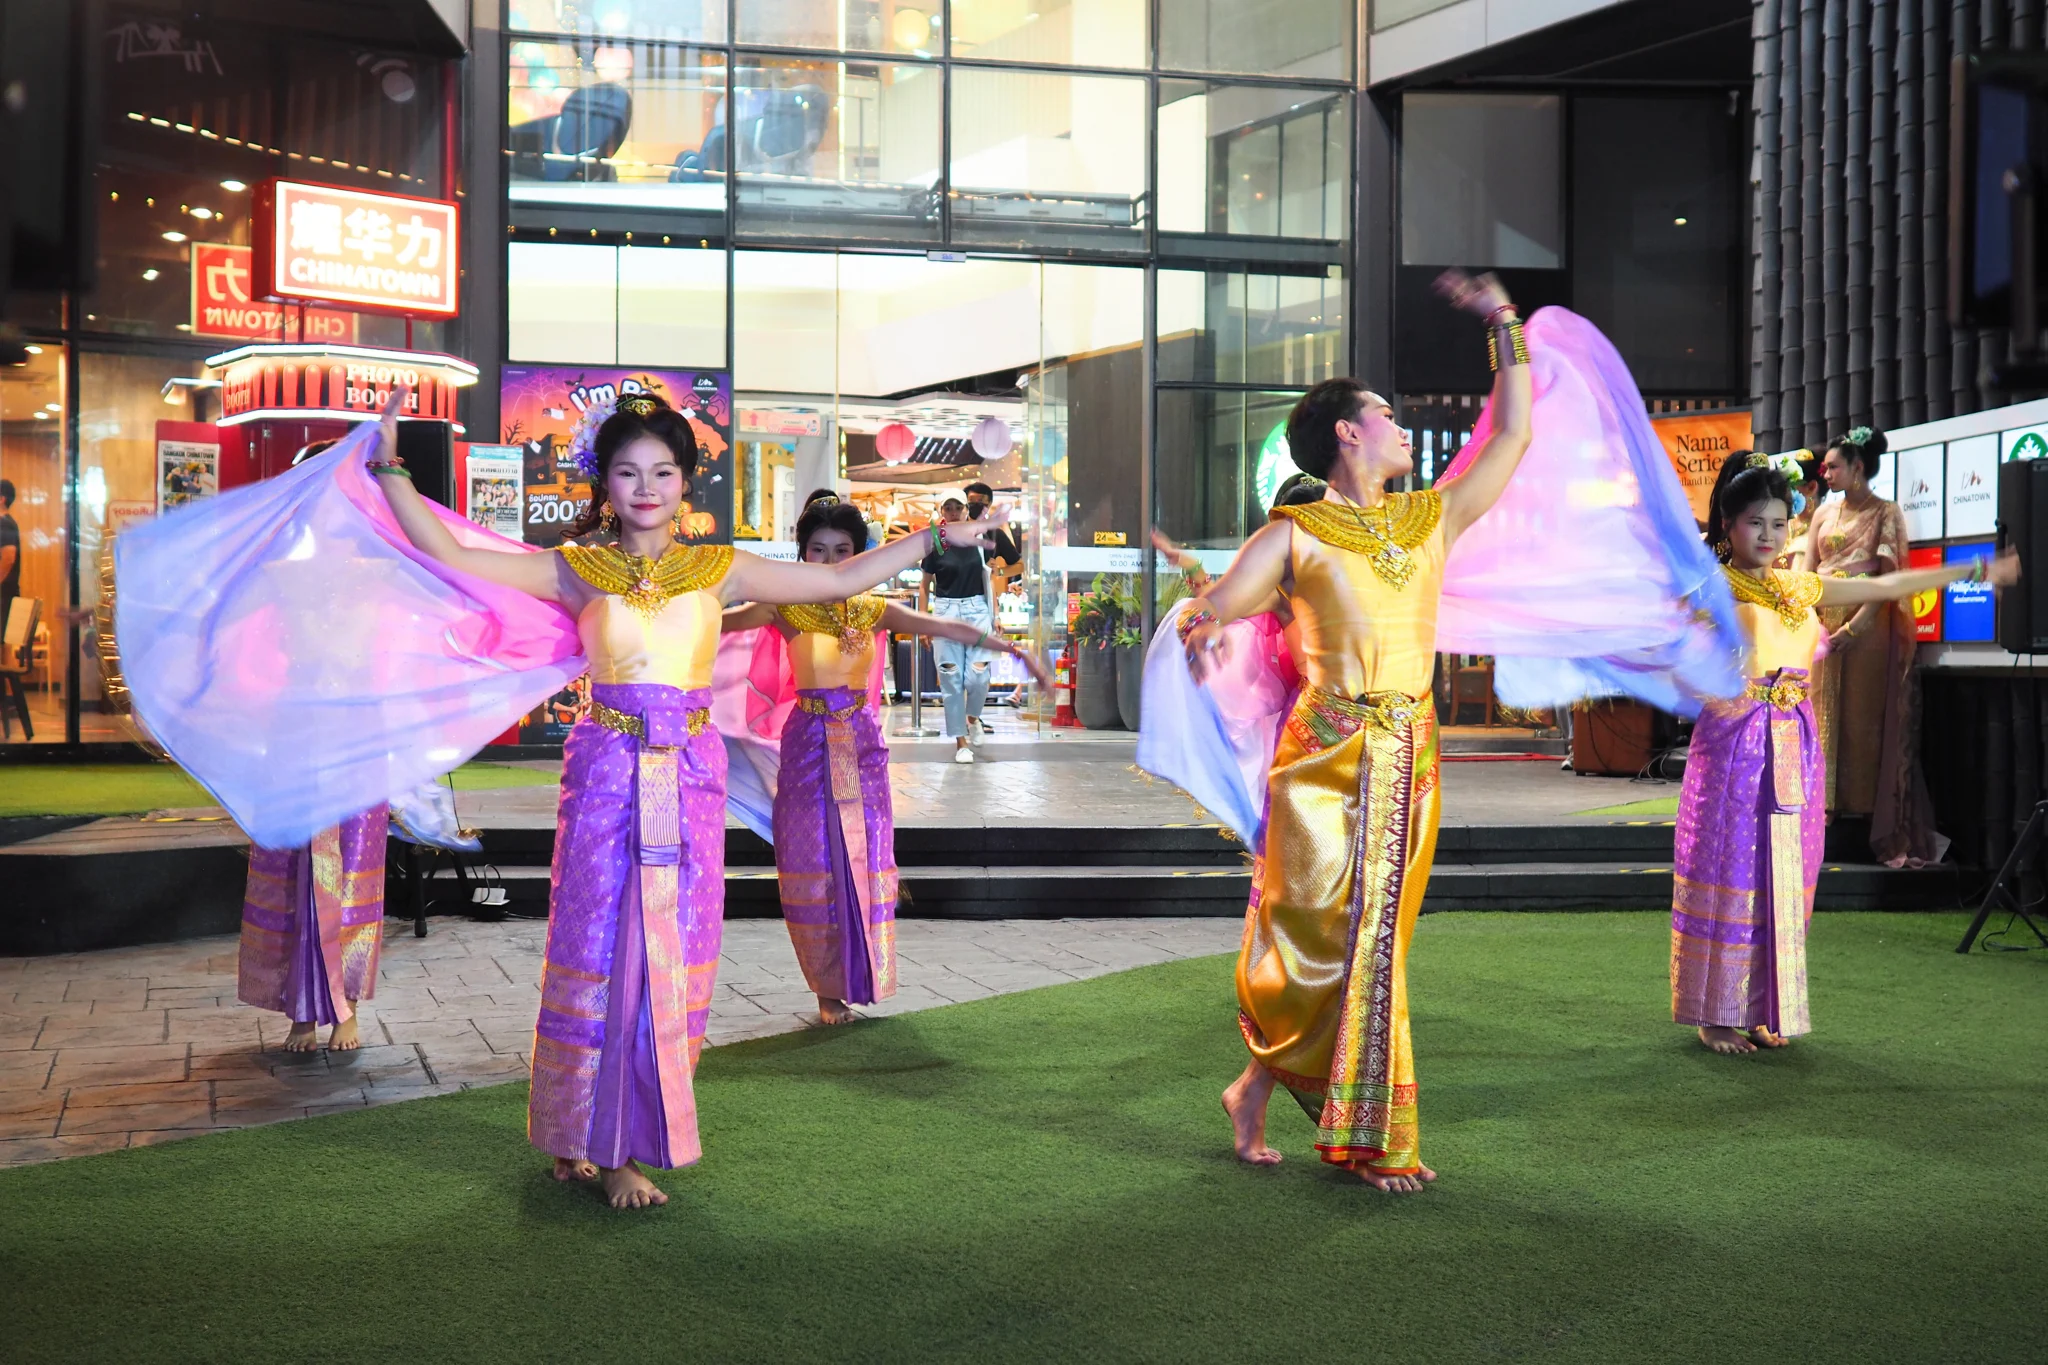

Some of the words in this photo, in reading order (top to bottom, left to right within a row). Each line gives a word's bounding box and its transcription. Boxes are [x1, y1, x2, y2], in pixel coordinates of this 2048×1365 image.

[290, 257, 441, 298] CHINATOWN
[346, 364, 419, 386] PHOTO
[225, 388, 250, 410] BOOTH
[346, 387, 418, 409] BOOH
[1676, 435, 1729, 453] Nama
[186, 451, 214, 459] CHINATOWN
[1903, 500, 1937, 512] CHINATOWN
[1953, 493, 1991, 504] CHINATOWN
[528, 500, 574, 524] 200
[1096, 533, 1107, 541] 24
[759, 552, 797, 560] CHINATO
